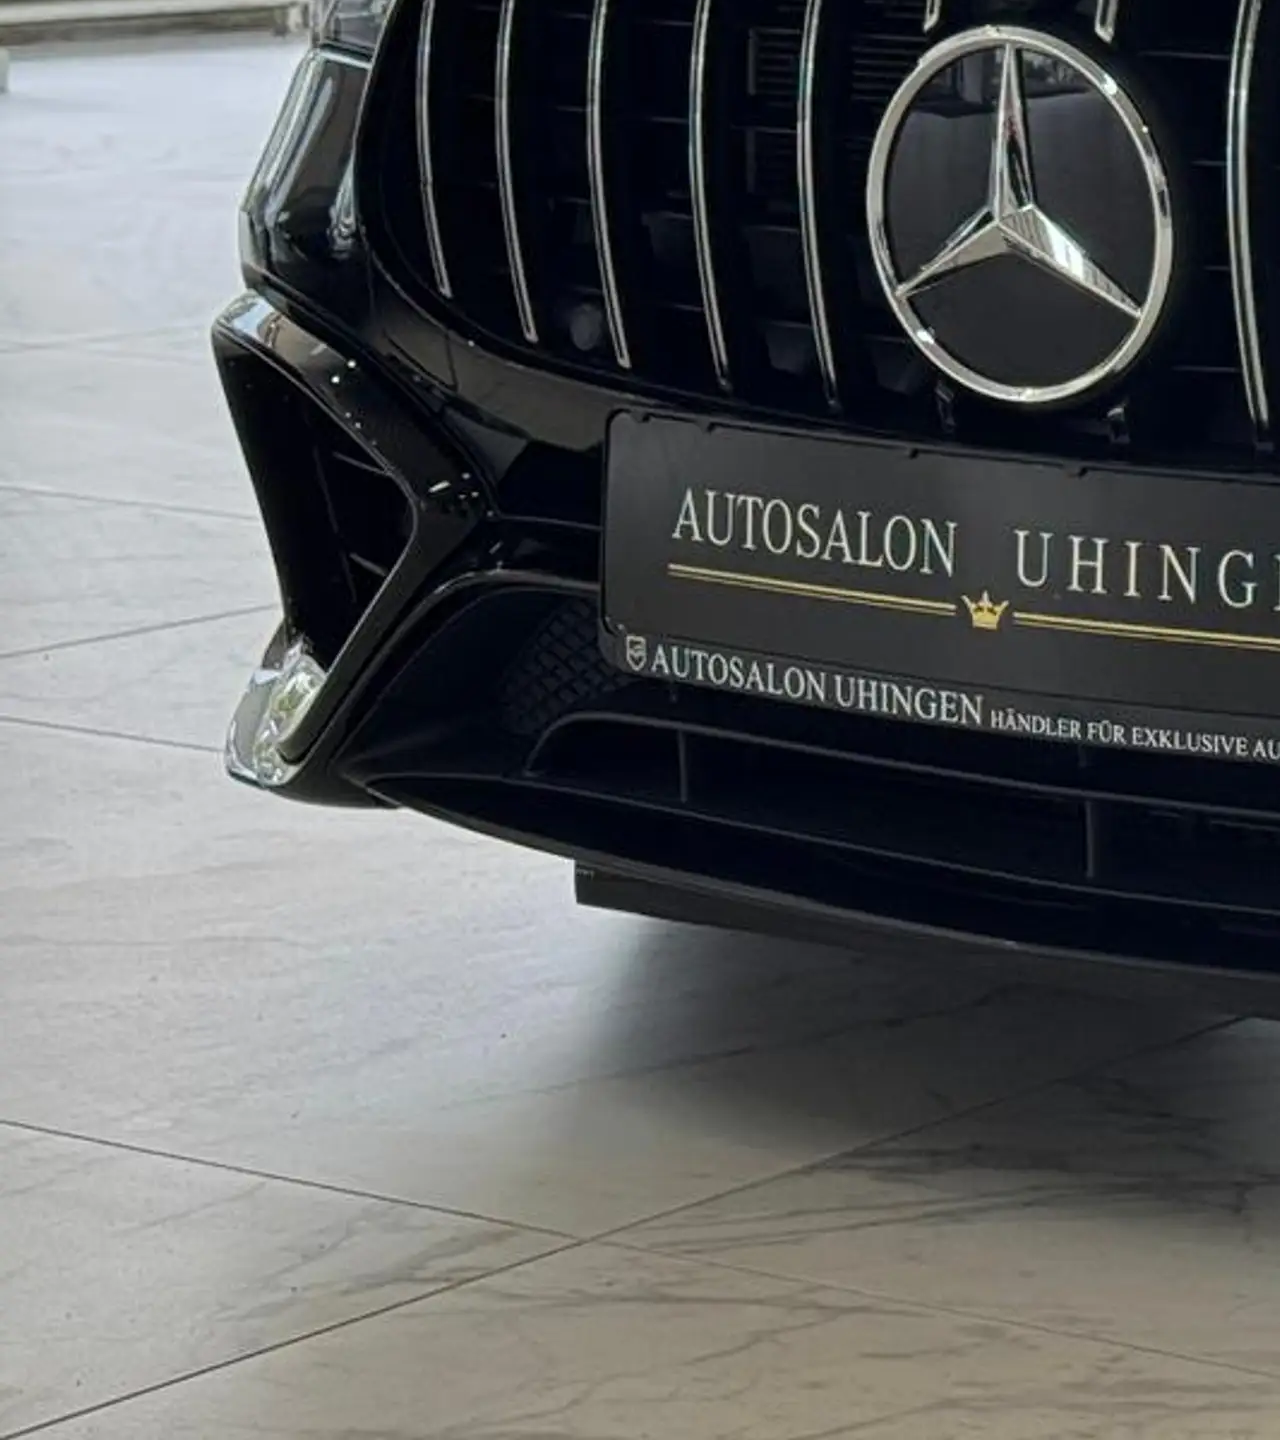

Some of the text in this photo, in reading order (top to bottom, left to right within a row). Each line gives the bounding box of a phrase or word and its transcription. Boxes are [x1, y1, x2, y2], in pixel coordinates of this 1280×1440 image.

[672, 487, 959, 578] AUTOSALON
[651, 643, 827, 705] AUTOSALON
[834, 674, 984, 727] UHINGEN
[991, 707, 1082, 741] HÄNDLER
[1087, 718, 1128, 746] FÜR
[1131, 727, 1249, 757] EXKLUSIVE
